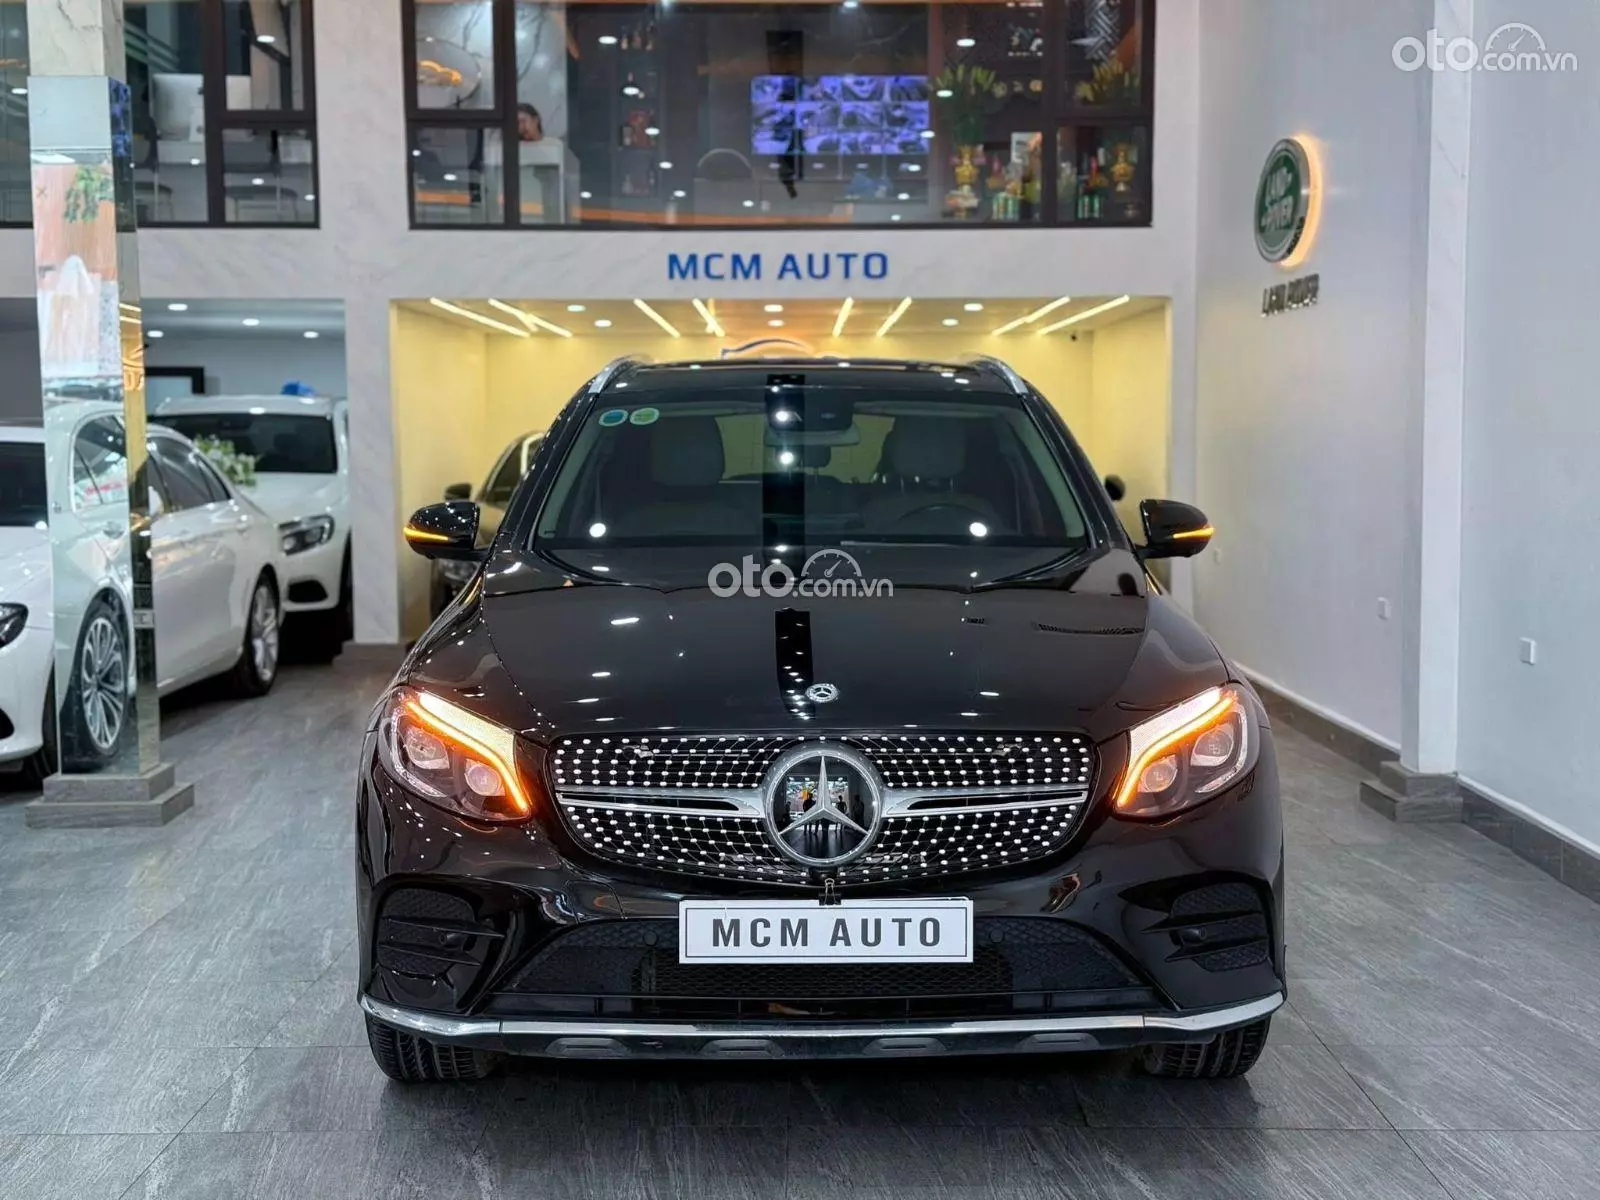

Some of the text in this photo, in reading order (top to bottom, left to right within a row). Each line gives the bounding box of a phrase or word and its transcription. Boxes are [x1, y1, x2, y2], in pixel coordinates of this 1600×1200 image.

[668, 253, 889, 281] MCM AUTO
[712, 917, 941, 948] MCM AUTO
